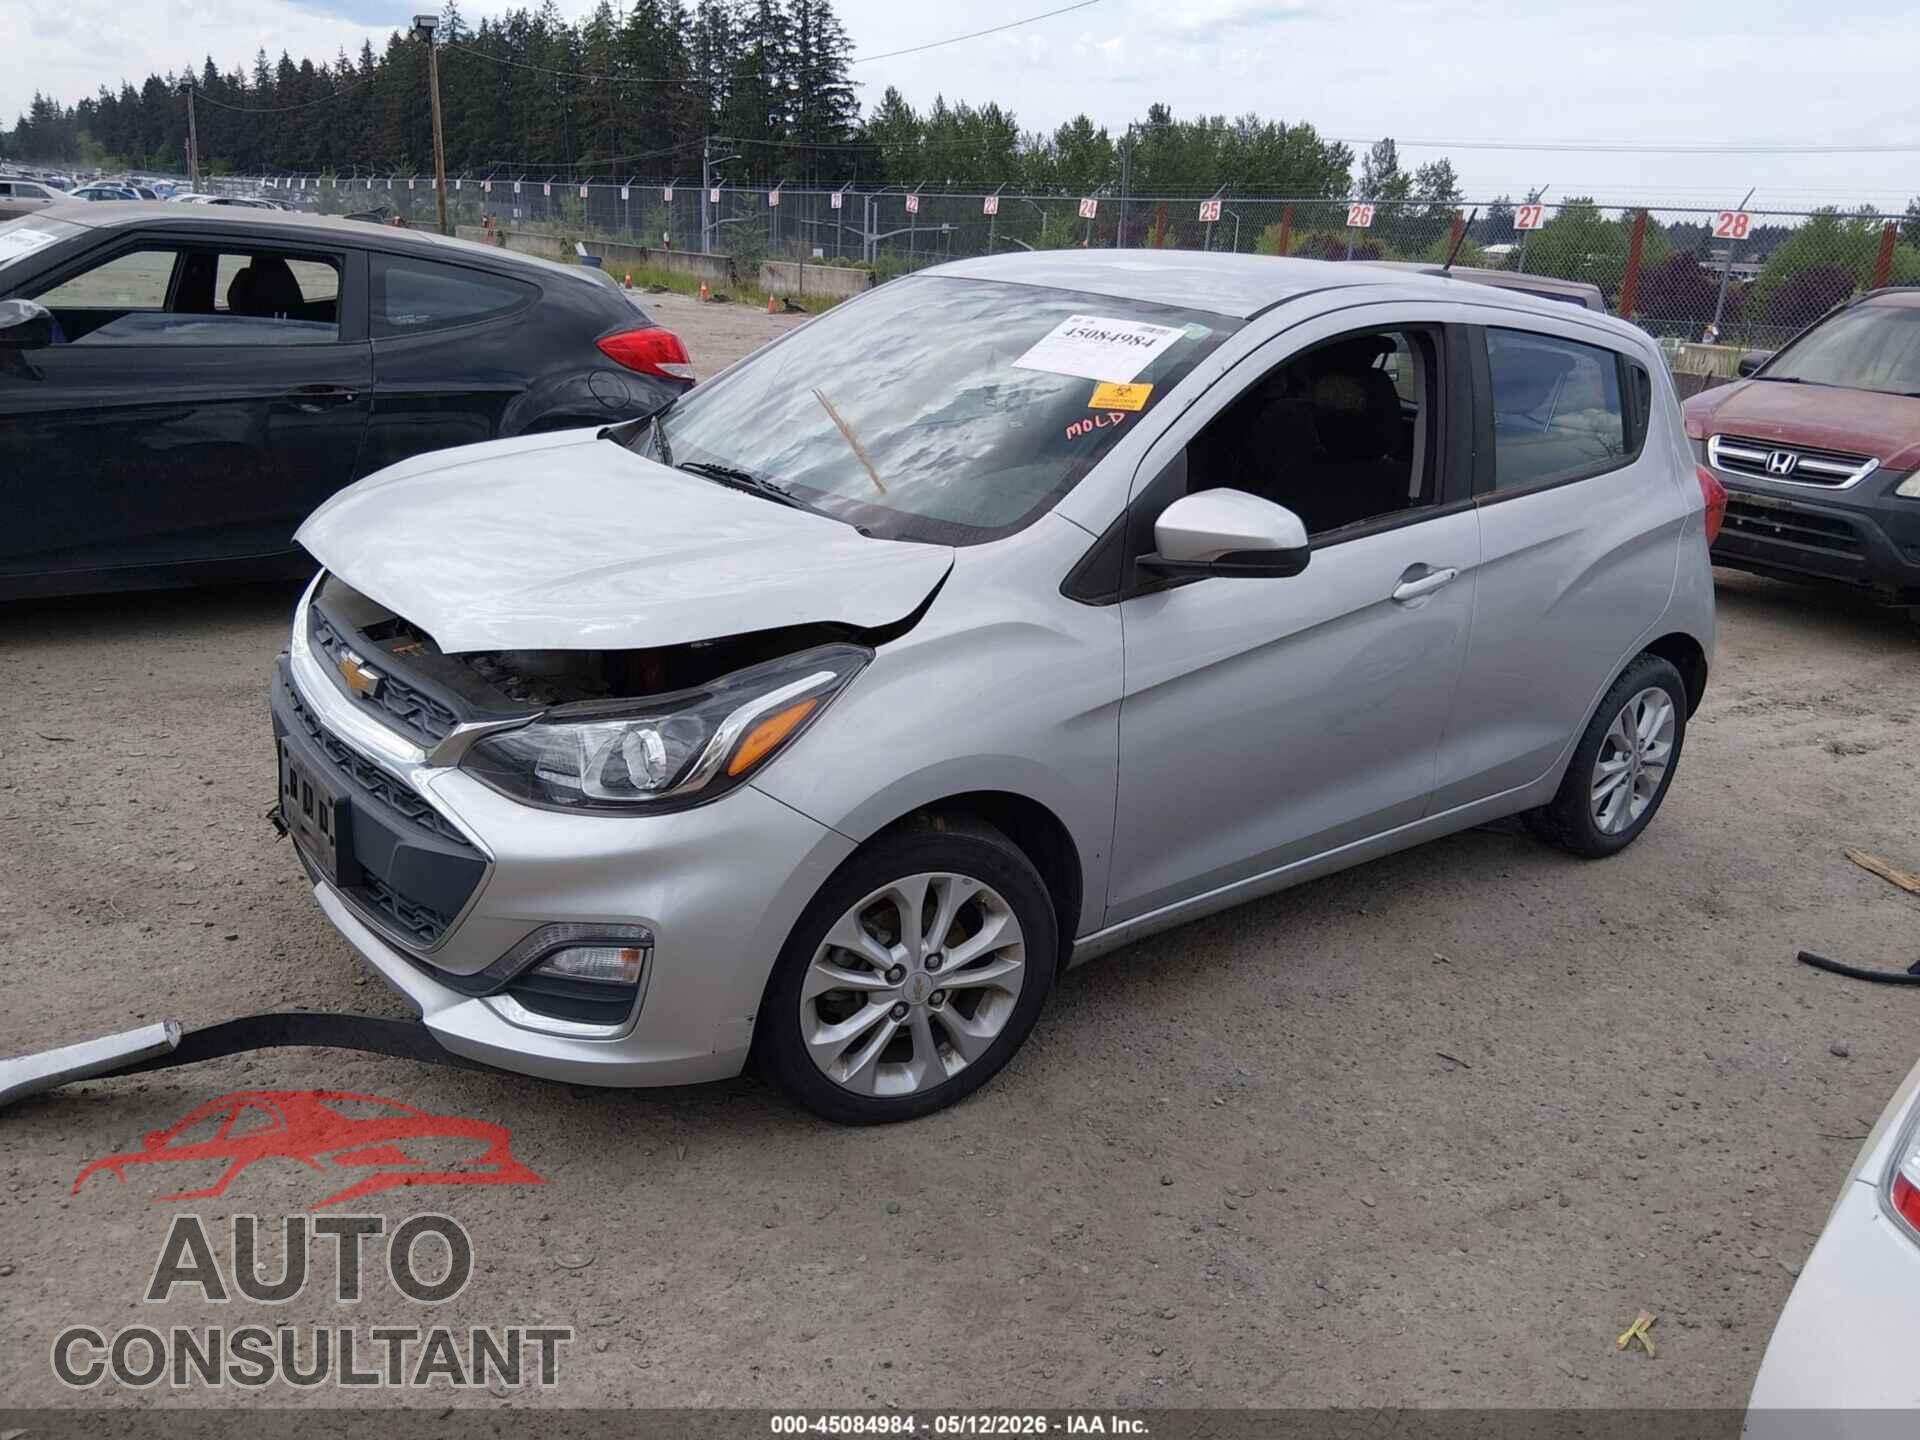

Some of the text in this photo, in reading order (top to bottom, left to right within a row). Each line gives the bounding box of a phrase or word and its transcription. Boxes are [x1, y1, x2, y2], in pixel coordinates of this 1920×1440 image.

[907, 197, 918, 212] 22
[1080, 200, 1095, 218] 24
[1200, 202, 1219, 220] 25
[1349, 205, 1371, 225] 26
[1518, 206, 1542, 229] 27
[1716, 212, 1749, 237] 28
[1063, 326, 1157, 348] 45084984
[1066, 411, 1125, 440] MOLD
